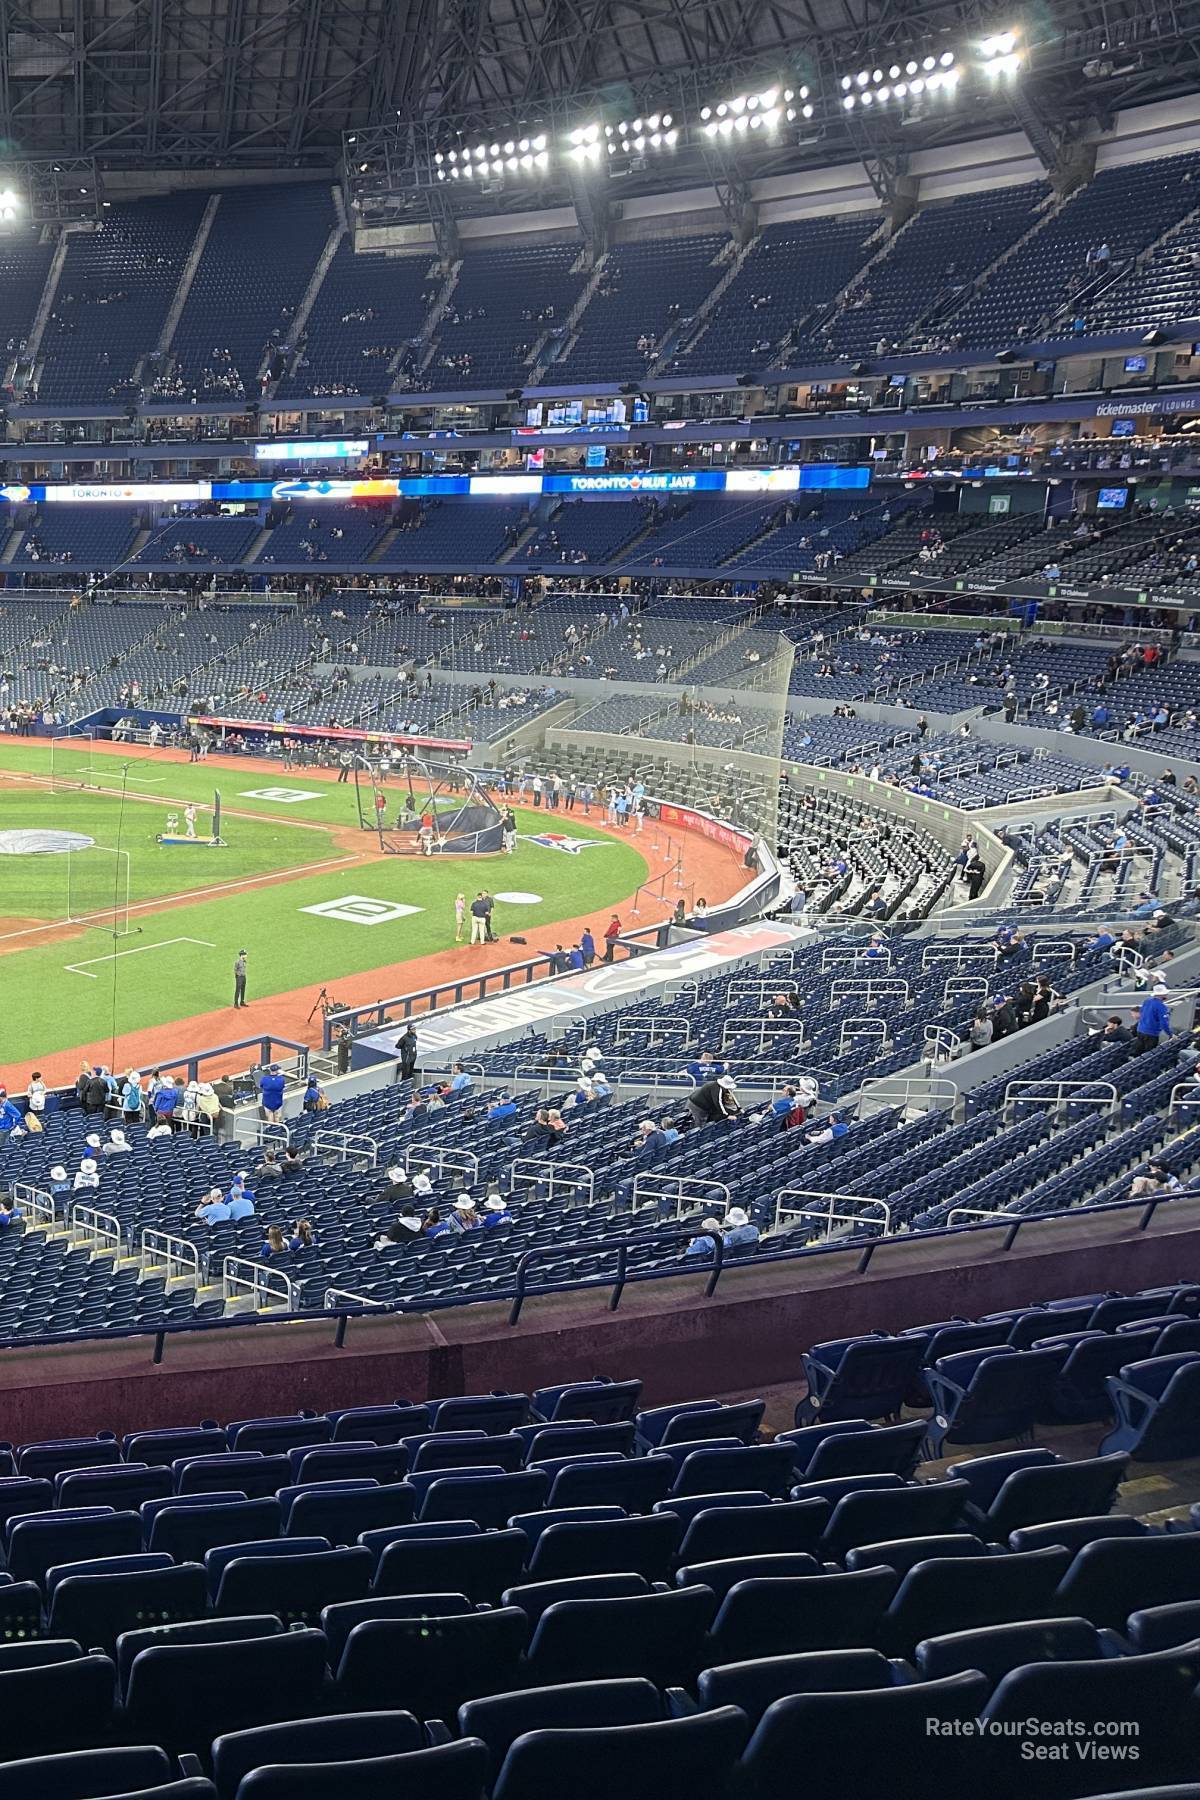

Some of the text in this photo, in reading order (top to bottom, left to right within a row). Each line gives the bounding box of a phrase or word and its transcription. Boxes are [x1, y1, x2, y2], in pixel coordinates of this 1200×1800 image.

[1096, 400, 1196, 416] ticketmaster LOUNGE
[571, 475, 696, 490] TORONTO BLUE JAYS
[72, 488, 122, 498] TORONTO
